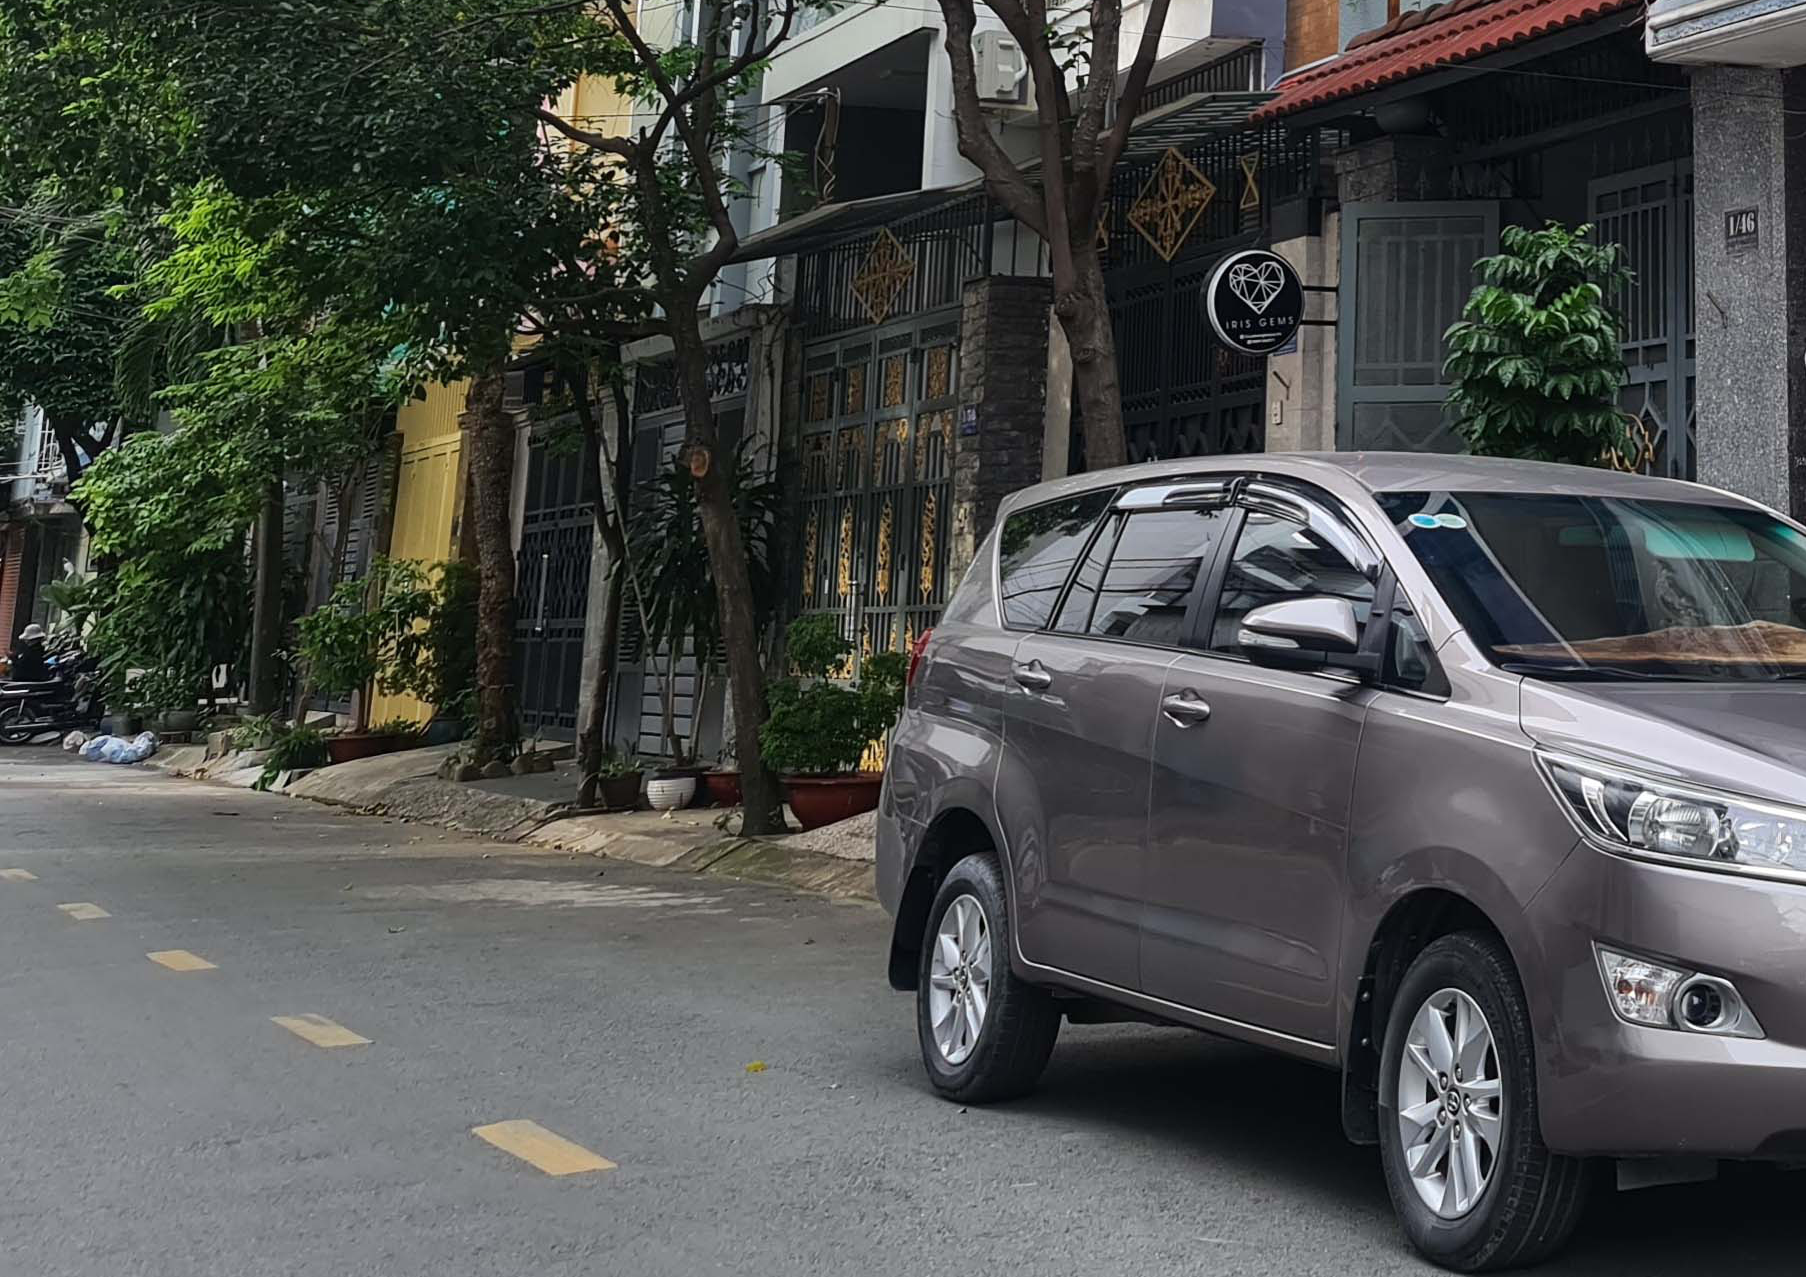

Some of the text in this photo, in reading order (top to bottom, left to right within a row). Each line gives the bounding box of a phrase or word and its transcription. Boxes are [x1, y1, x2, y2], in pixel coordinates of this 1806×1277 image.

[1728, 211, 1755, 237] 1/46
[1225, 315, 1294, 330] IRIS GEMS
